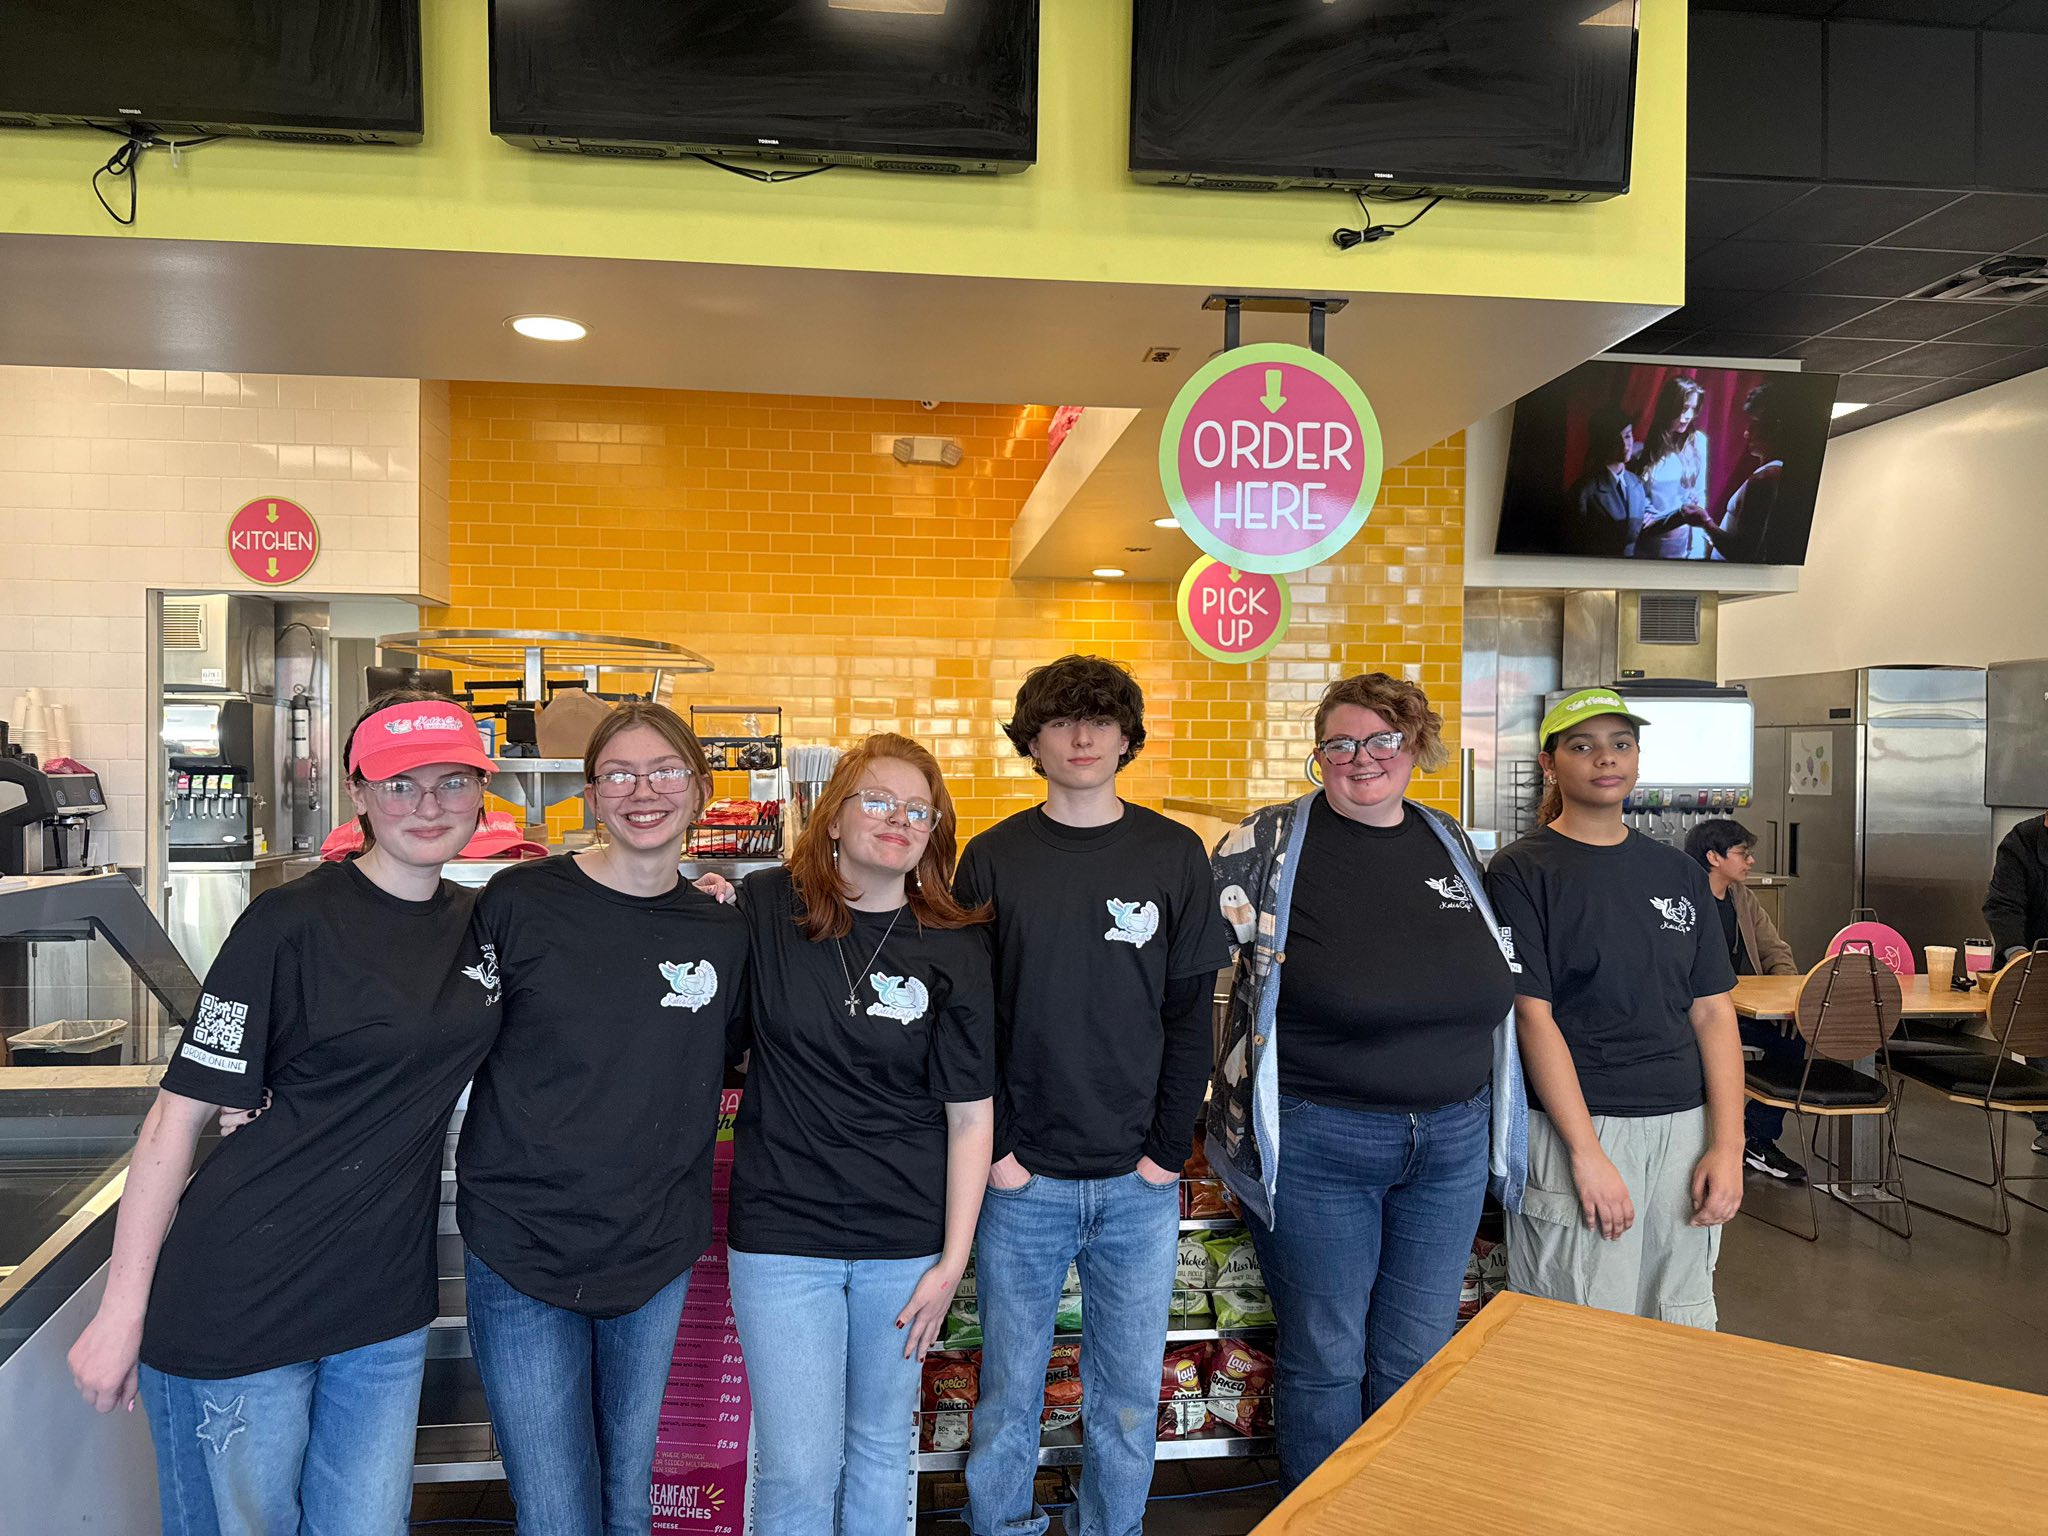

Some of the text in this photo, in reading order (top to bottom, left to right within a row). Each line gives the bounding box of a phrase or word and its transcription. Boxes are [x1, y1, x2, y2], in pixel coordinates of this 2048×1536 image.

[1193, 419, 1353, 471] ORDER
[1213, 480, 1327, 531] HERE
[232, 530, 313, 551] KITCHEN
[1202, 586, 1269, 616] PICK
[1217, 618, 1254, 647] UP
[183, 1046, 244, 1071] ORDER ONLINE
[1223, 1261, 1248, 1274] Miss
[722, 1353, 743, 1364] $8.49
[1227, 1354, 1252, 1373] Lay's
[720, 1373, 742, 1384] $9.49
[1176, 1363, 1197, 1383] Lay's
[1211, 1372, 1245, 1391] BAKED
[934, 1376, 968, 1396] Cheetos
[720, 1393, 741, 1404] $9.49
[718, 1412, 740, 1423] $7.49
[717, 1439, 739, 1449] $5.99
[652, 1505, 712, 1520] DWICHES
[652, 1522, 679, 1530] CHEESE
[714, 1525, 732, 1534] $7.50
